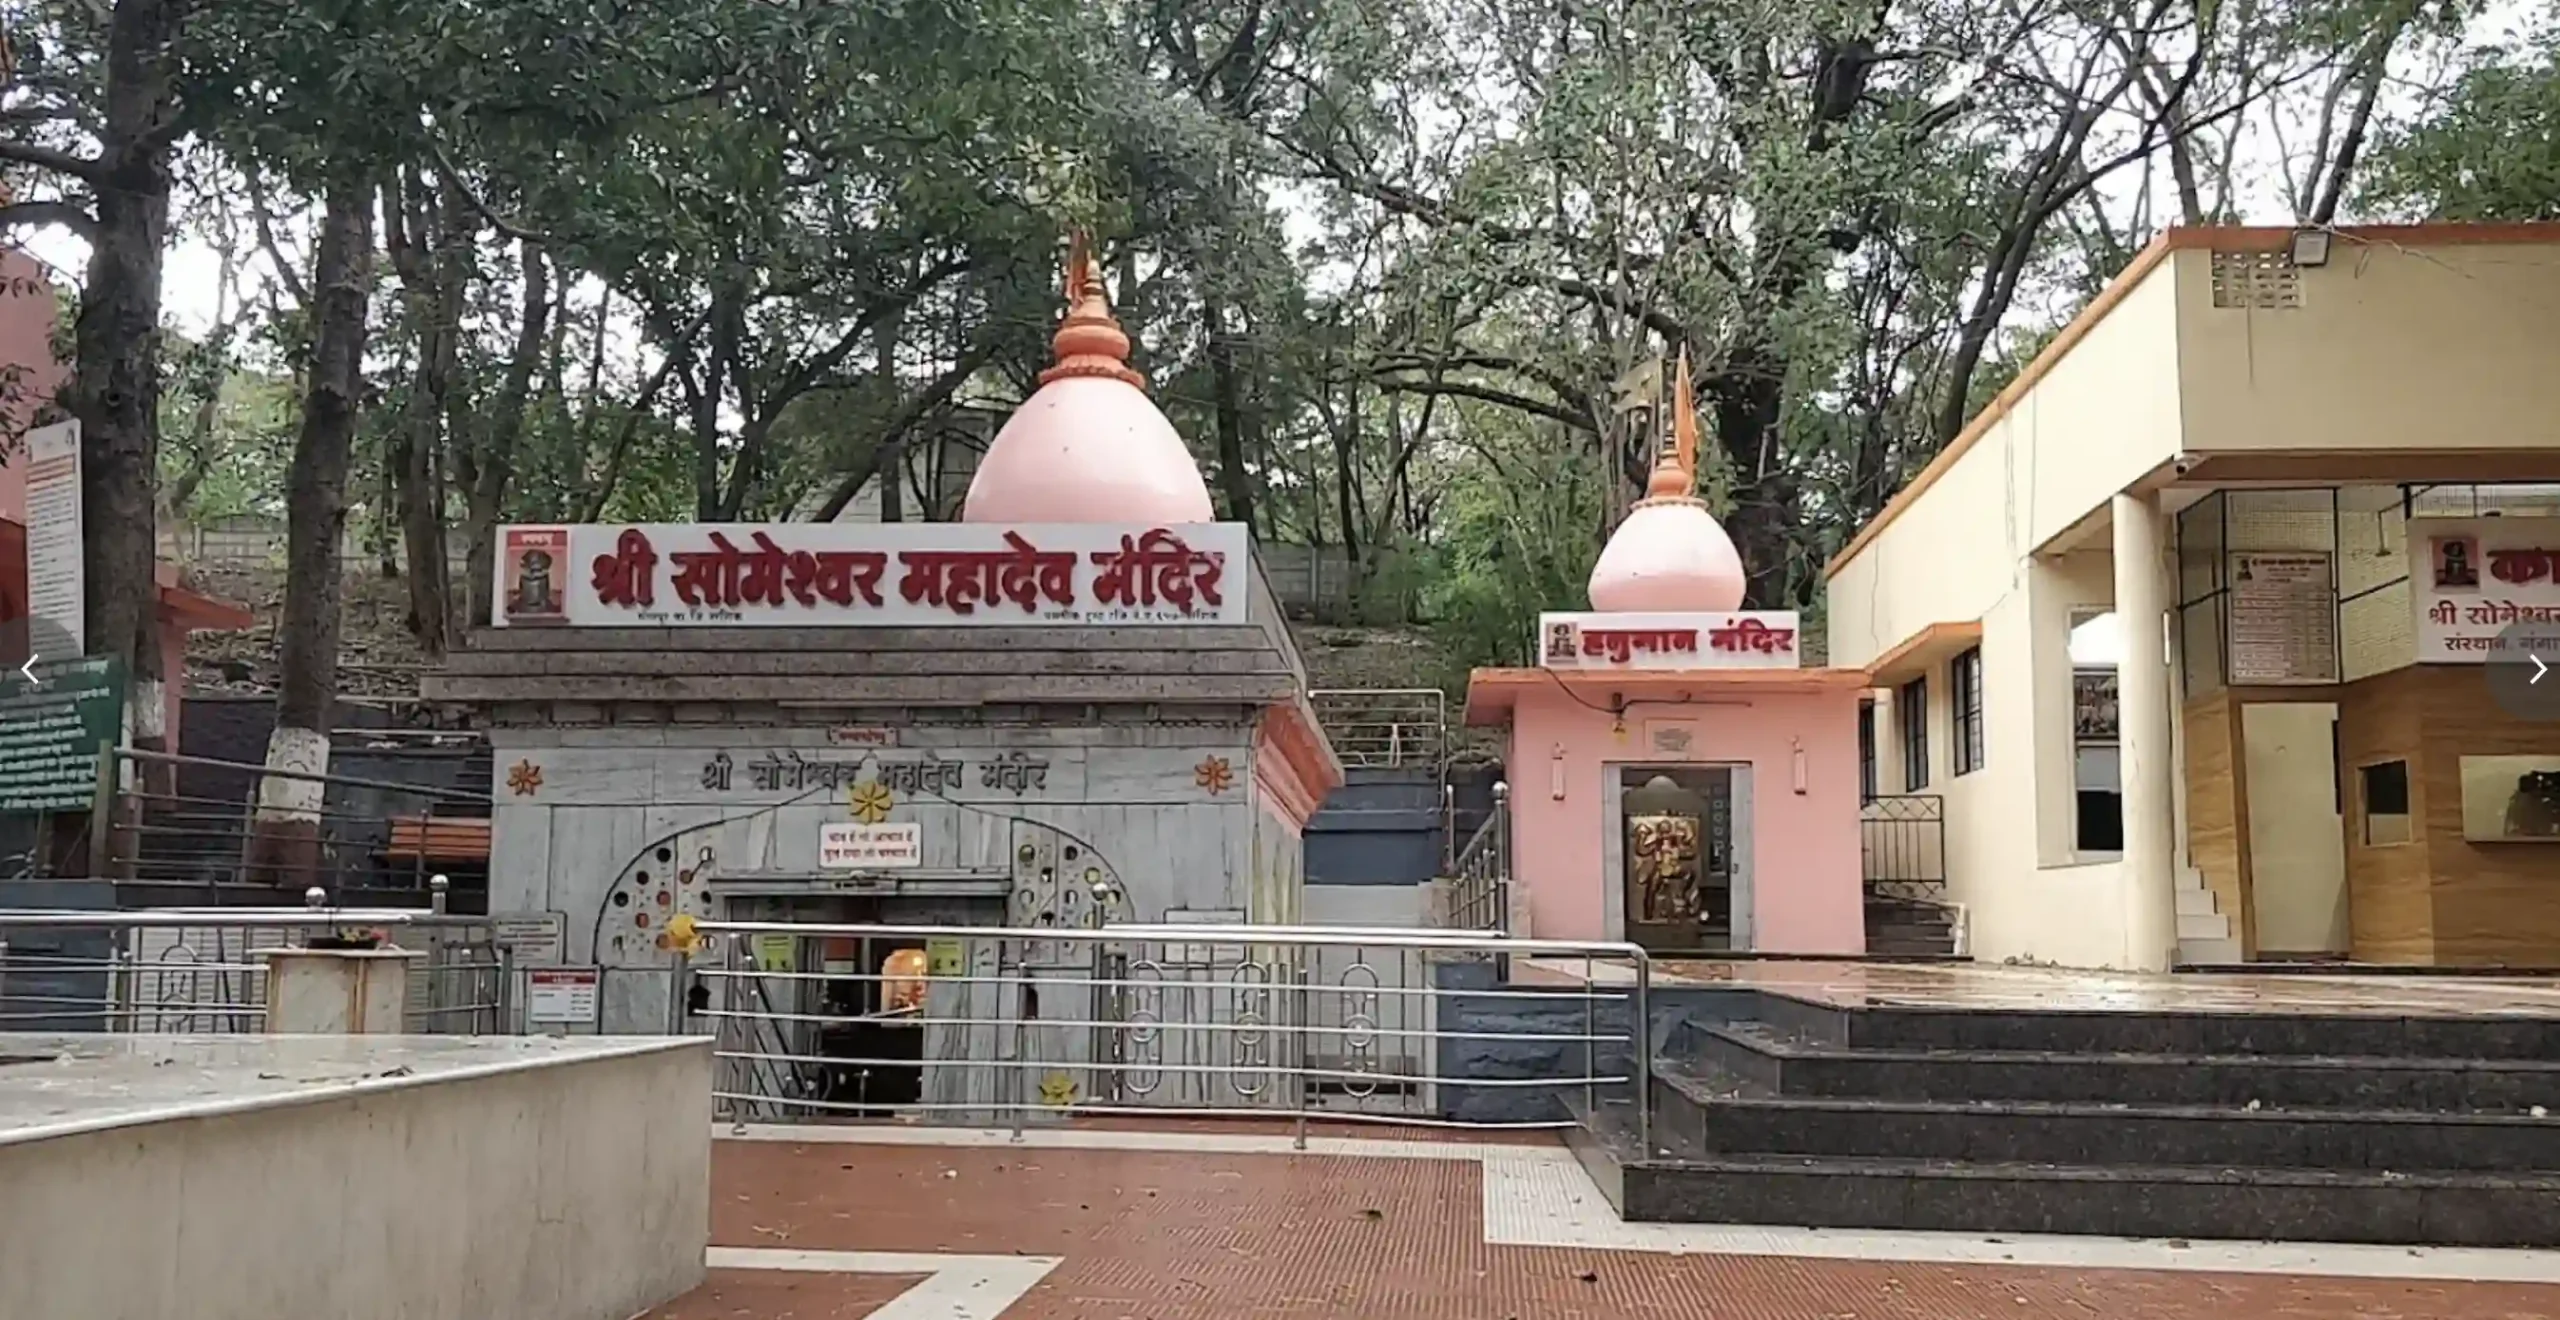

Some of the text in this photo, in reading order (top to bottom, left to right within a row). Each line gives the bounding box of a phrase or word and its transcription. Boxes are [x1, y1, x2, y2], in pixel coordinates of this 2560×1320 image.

[591, 528, 1225, 614] श्री सोमेश्वर महादेव मंदिर
[2429, 600, 2457, 625] श्री
[1581, 618, 1794, 663] हनुमान मंदिर
[701, 752, 733, 791] श्री
